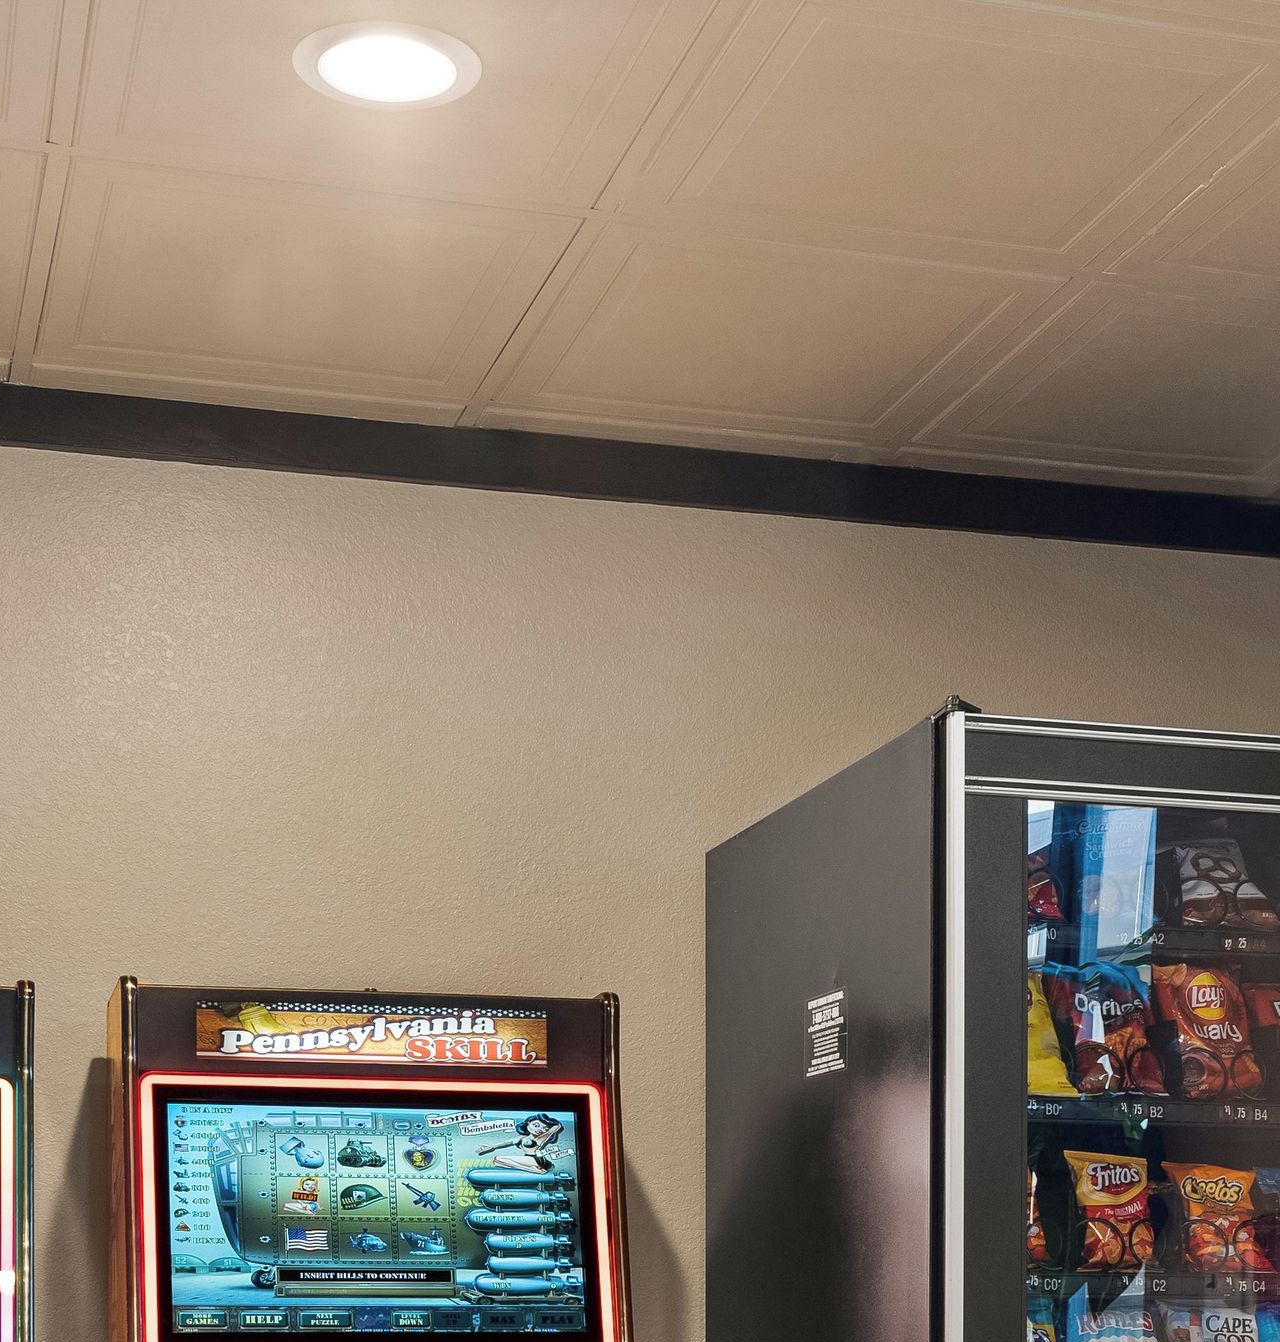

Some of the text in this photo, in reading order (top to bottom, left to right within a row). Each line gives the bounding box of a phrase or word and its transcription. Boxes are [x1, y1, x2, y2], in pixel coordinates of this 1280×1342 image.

[220, 1010, 496, 1053] Pennsylvania
[1193, 1021, 1243, 1043] wavy
[405, 1035, 537, 1064] SKILL
[1045, 1103, 1060, 1115] B0
[1149, 1106, 1164, 1118] B2
[1254, 1109, 1268, 1121] B4
[461, 1122, 514, 1134] Bombshells
[1087, 1162, 1140, 1191] Fritos
[292, 1192, 318, 1201] WILD!
[175, 1256, 187, 1264] 52
[379, 1272, 427, 1280] CONTINUE
[1044, 1278, 1059, 1290] C0
[1252, 1280, 1266, 1293] C4
[185, 1317, 219, 1325] GAMES
[245, 1315, 283, 1324] HELP
[399, 1318, 424, 1326] DOWN
[489, 1316, 516, 1325] MAX
[541, 1316, 575, 1325] PLAY
[1205, 1314, 1253, 1334] CAPE
